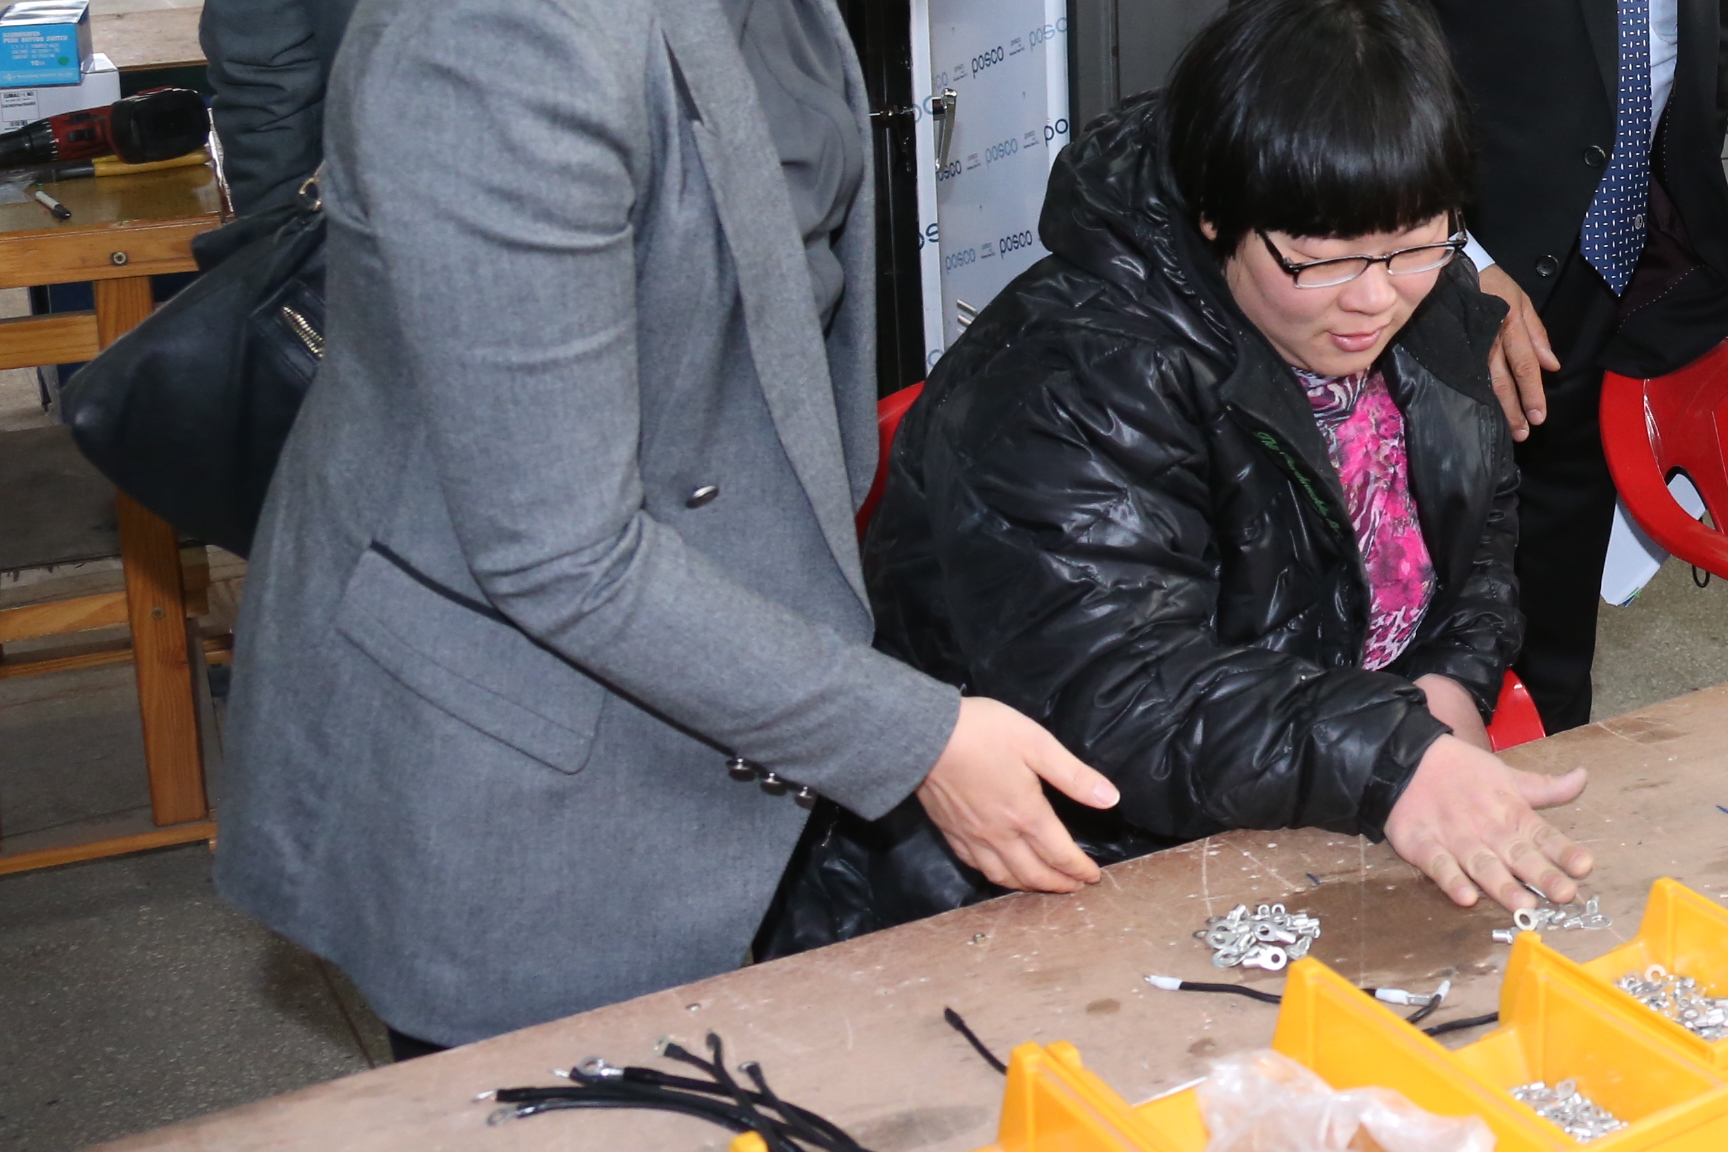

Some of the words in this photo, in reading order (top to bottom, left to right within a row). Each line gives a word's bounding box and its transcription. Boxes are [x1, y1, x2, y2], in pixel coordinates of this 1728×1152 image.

[1028, 16, 1067, 52] posc
[971, 45, 1004, 79] posco
[985, 138, 1018, 169] posco
[937, 160, 962, 182] osco
[999, 230, 1032, 259] posco
[944, 249, 976, 275] posco
